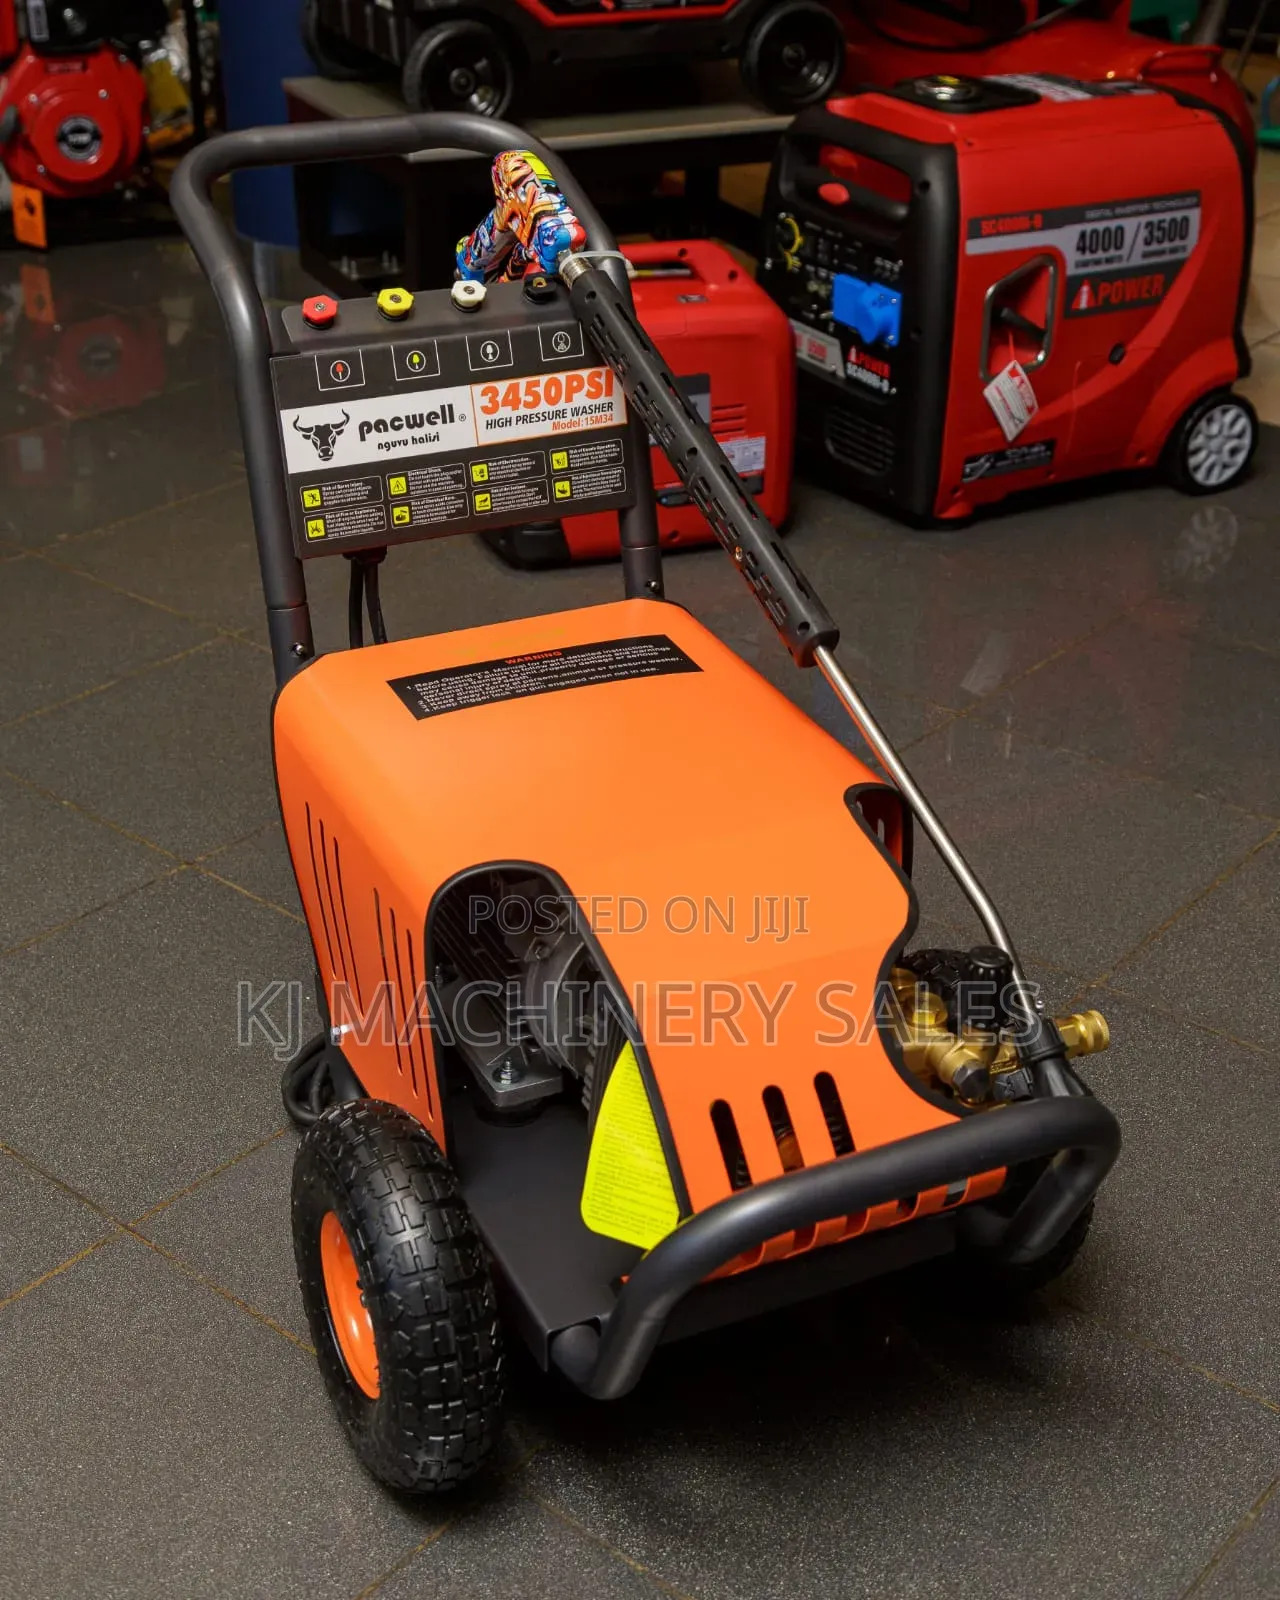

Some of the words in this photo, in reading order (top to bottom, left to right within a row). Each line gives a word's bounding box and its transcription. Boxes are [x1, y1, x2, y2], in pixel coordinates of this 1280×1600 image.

[1076, 224, 1124, 255] 4000
[1144, 215, 1190, 246] 3500
[480, 369, 614, 415] 3450PSI
[358, 403, 455, 442] pacwell
[485, 416, 512, 430] HIGH
[515, 408, 568, 426] PRESSURE
[570, 401, 614, 417] WASHER
[377, 438, 408, 452] nguvu
[504, 650, 562, 665] WARNING
